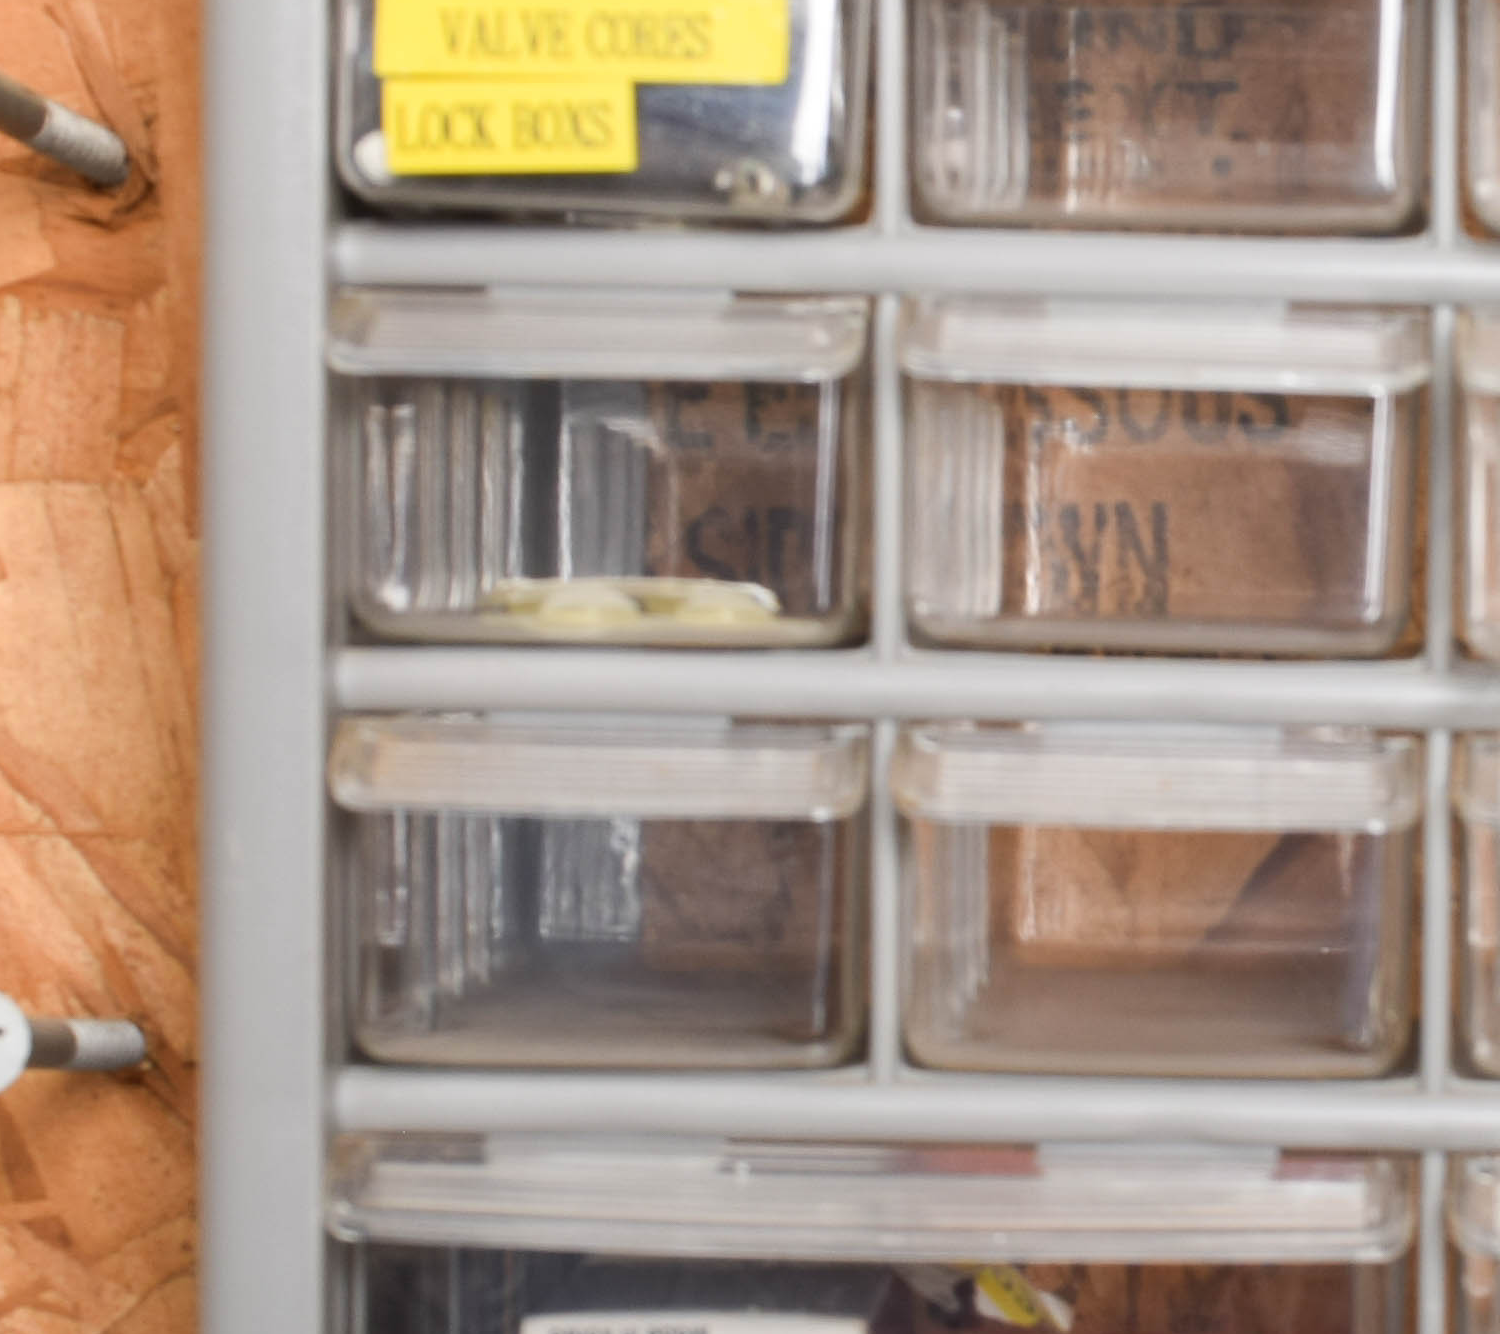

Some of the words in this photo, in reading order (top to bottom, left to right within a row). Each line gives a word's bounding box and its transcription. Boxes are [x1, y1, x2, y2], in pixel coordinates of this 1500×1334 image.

[437, 7, 567, 60] VALVE
[585, 9, 715, 61] CORES
[394, 99, 498, 152] LOCK
